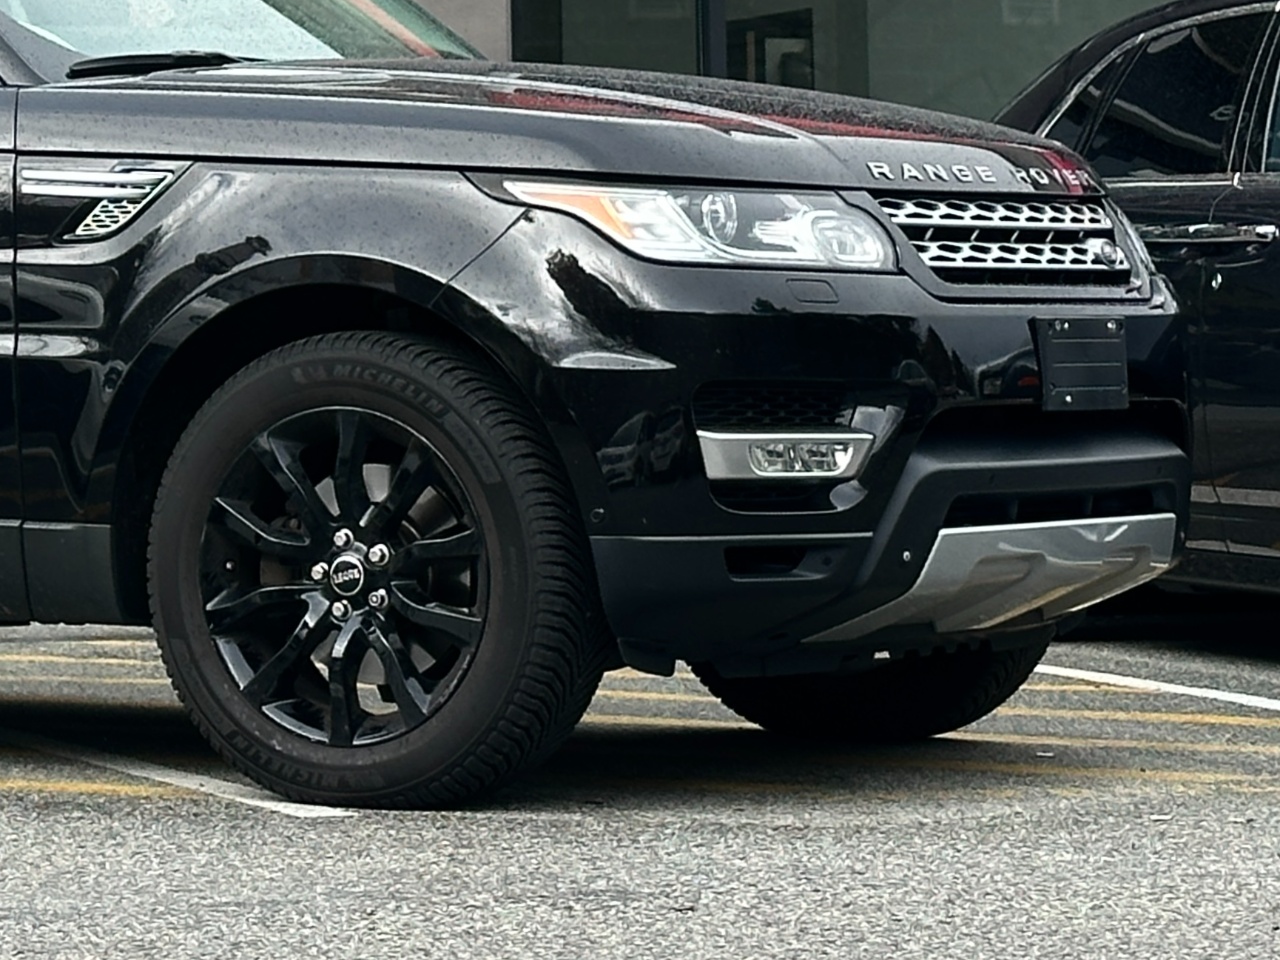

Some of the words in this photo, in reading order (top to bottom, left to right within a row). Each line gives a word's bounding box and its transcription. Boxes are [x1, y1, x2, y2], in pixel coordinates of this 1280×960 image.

[866, 161, 997, 183] RANGE
[1010, 166, 1095, 186] ROVER
[333, 363, 446, 416] MICHELIN
